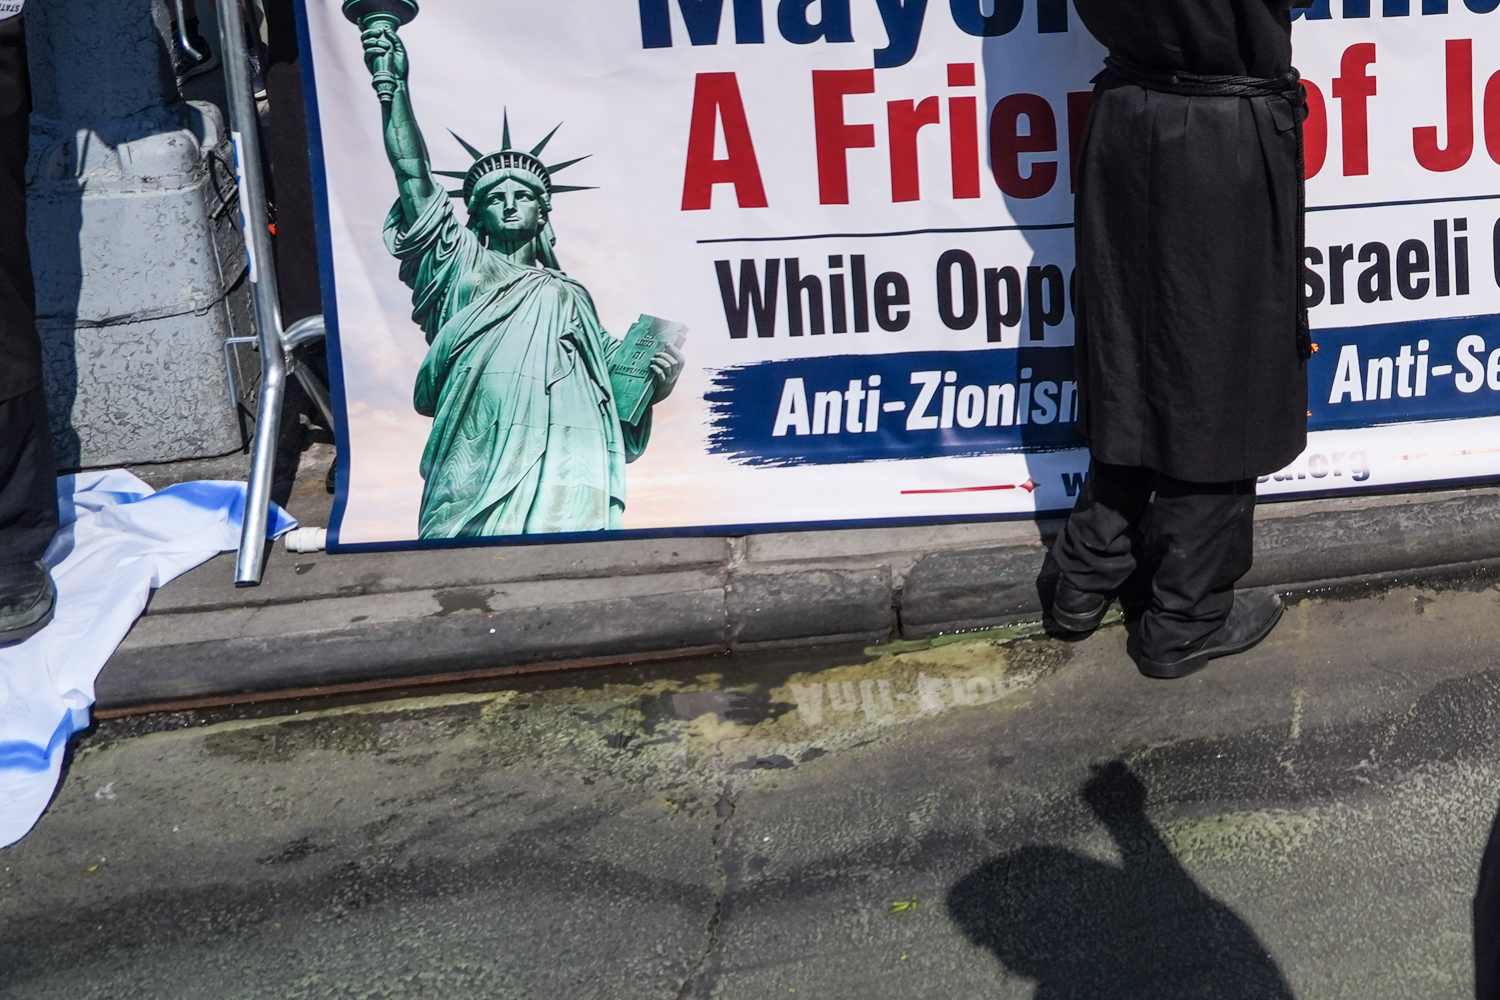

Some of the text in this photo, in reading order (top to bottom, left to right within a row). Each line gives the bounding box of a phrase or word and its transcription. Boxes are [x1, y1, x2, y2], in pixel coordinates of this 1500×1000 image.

[680, 71, 769, 212] A
[811, 62, 1095, 206] Frie
[714, 251, 911, 340] While
[935, 248, 1077, 343] Opp
[1303, 217, 1469, 309] sraeli
